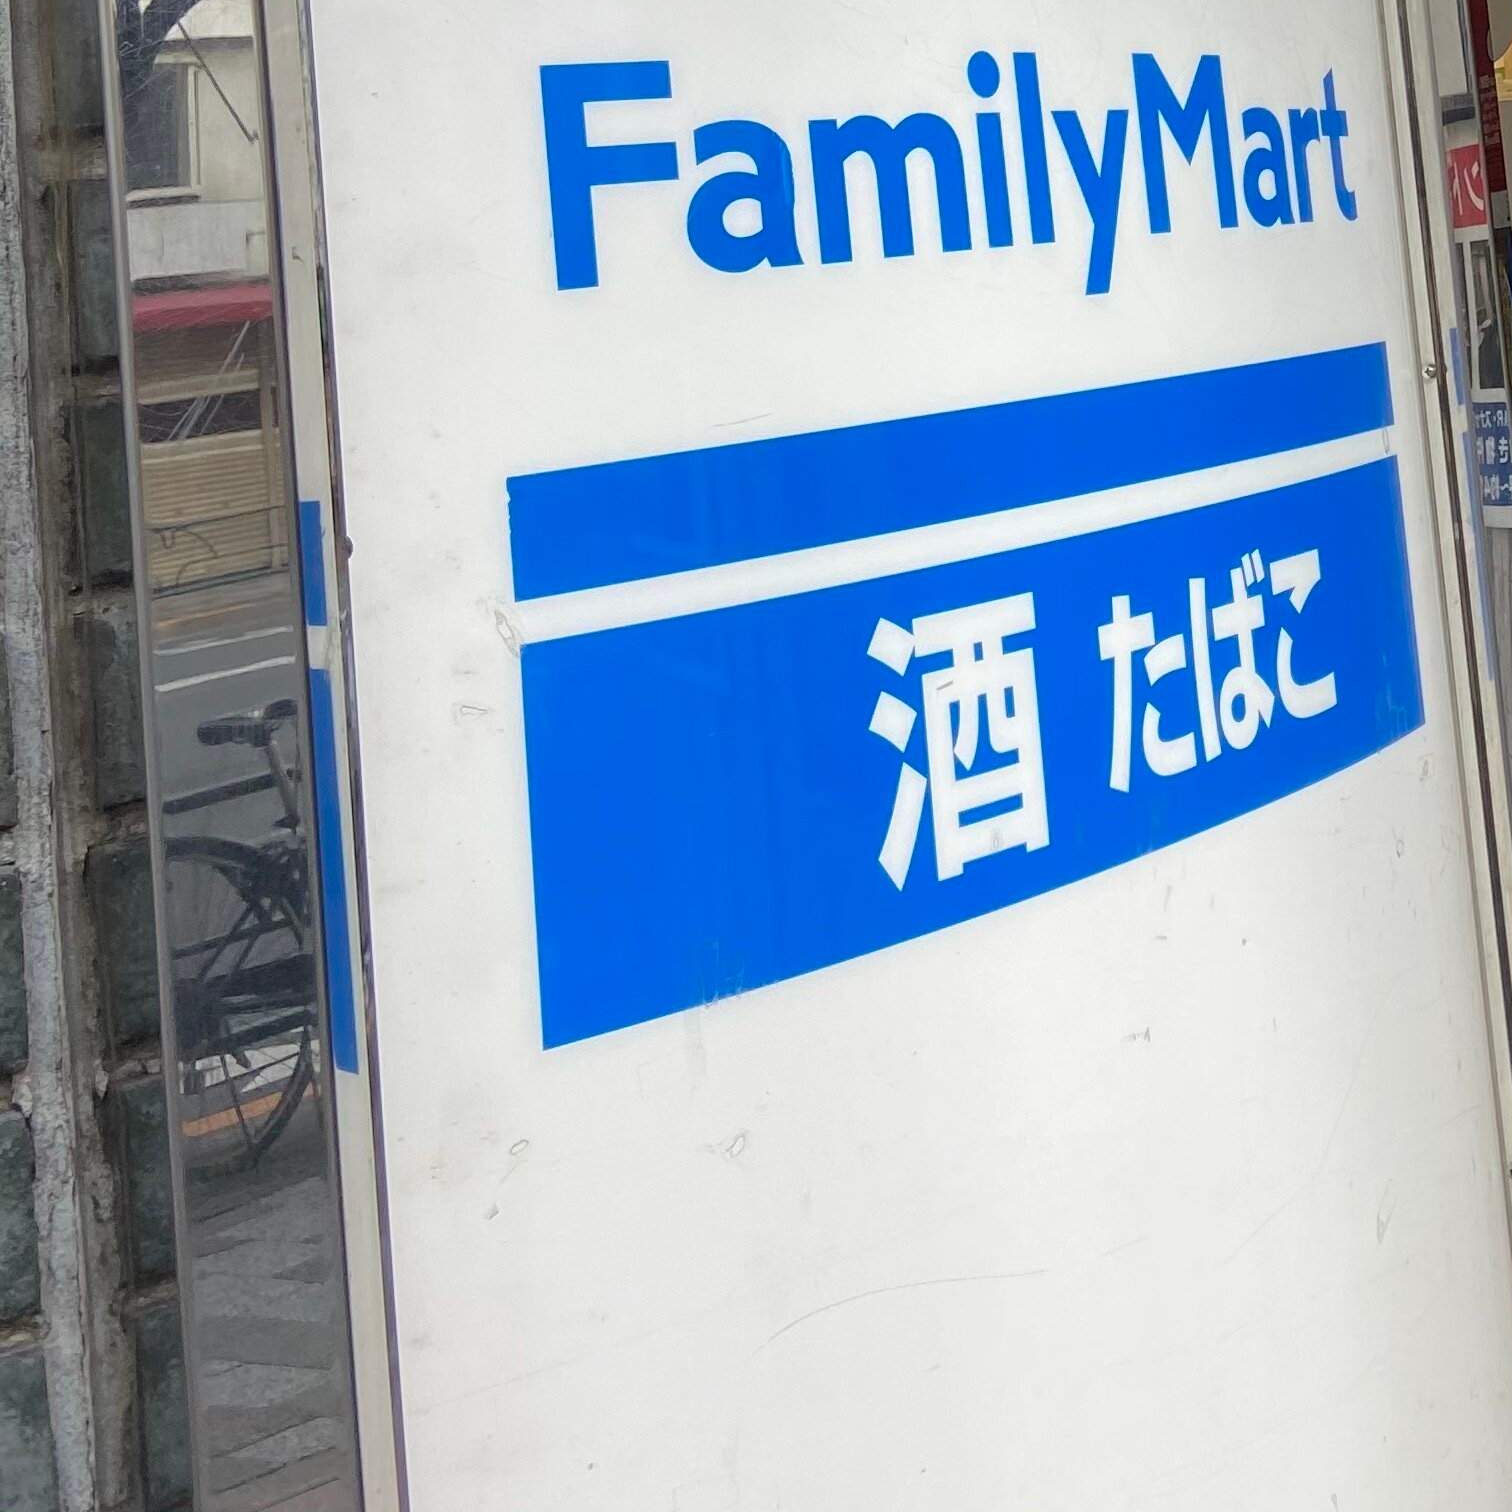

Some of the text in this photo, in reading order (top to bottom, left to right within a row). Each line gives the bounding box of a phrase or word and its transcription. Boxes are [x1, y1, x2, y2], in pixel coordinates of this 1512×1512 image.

[539, 50, 1358, 296] FamilyMart
[867, 548, 1338, 892] 酒 たばこ
